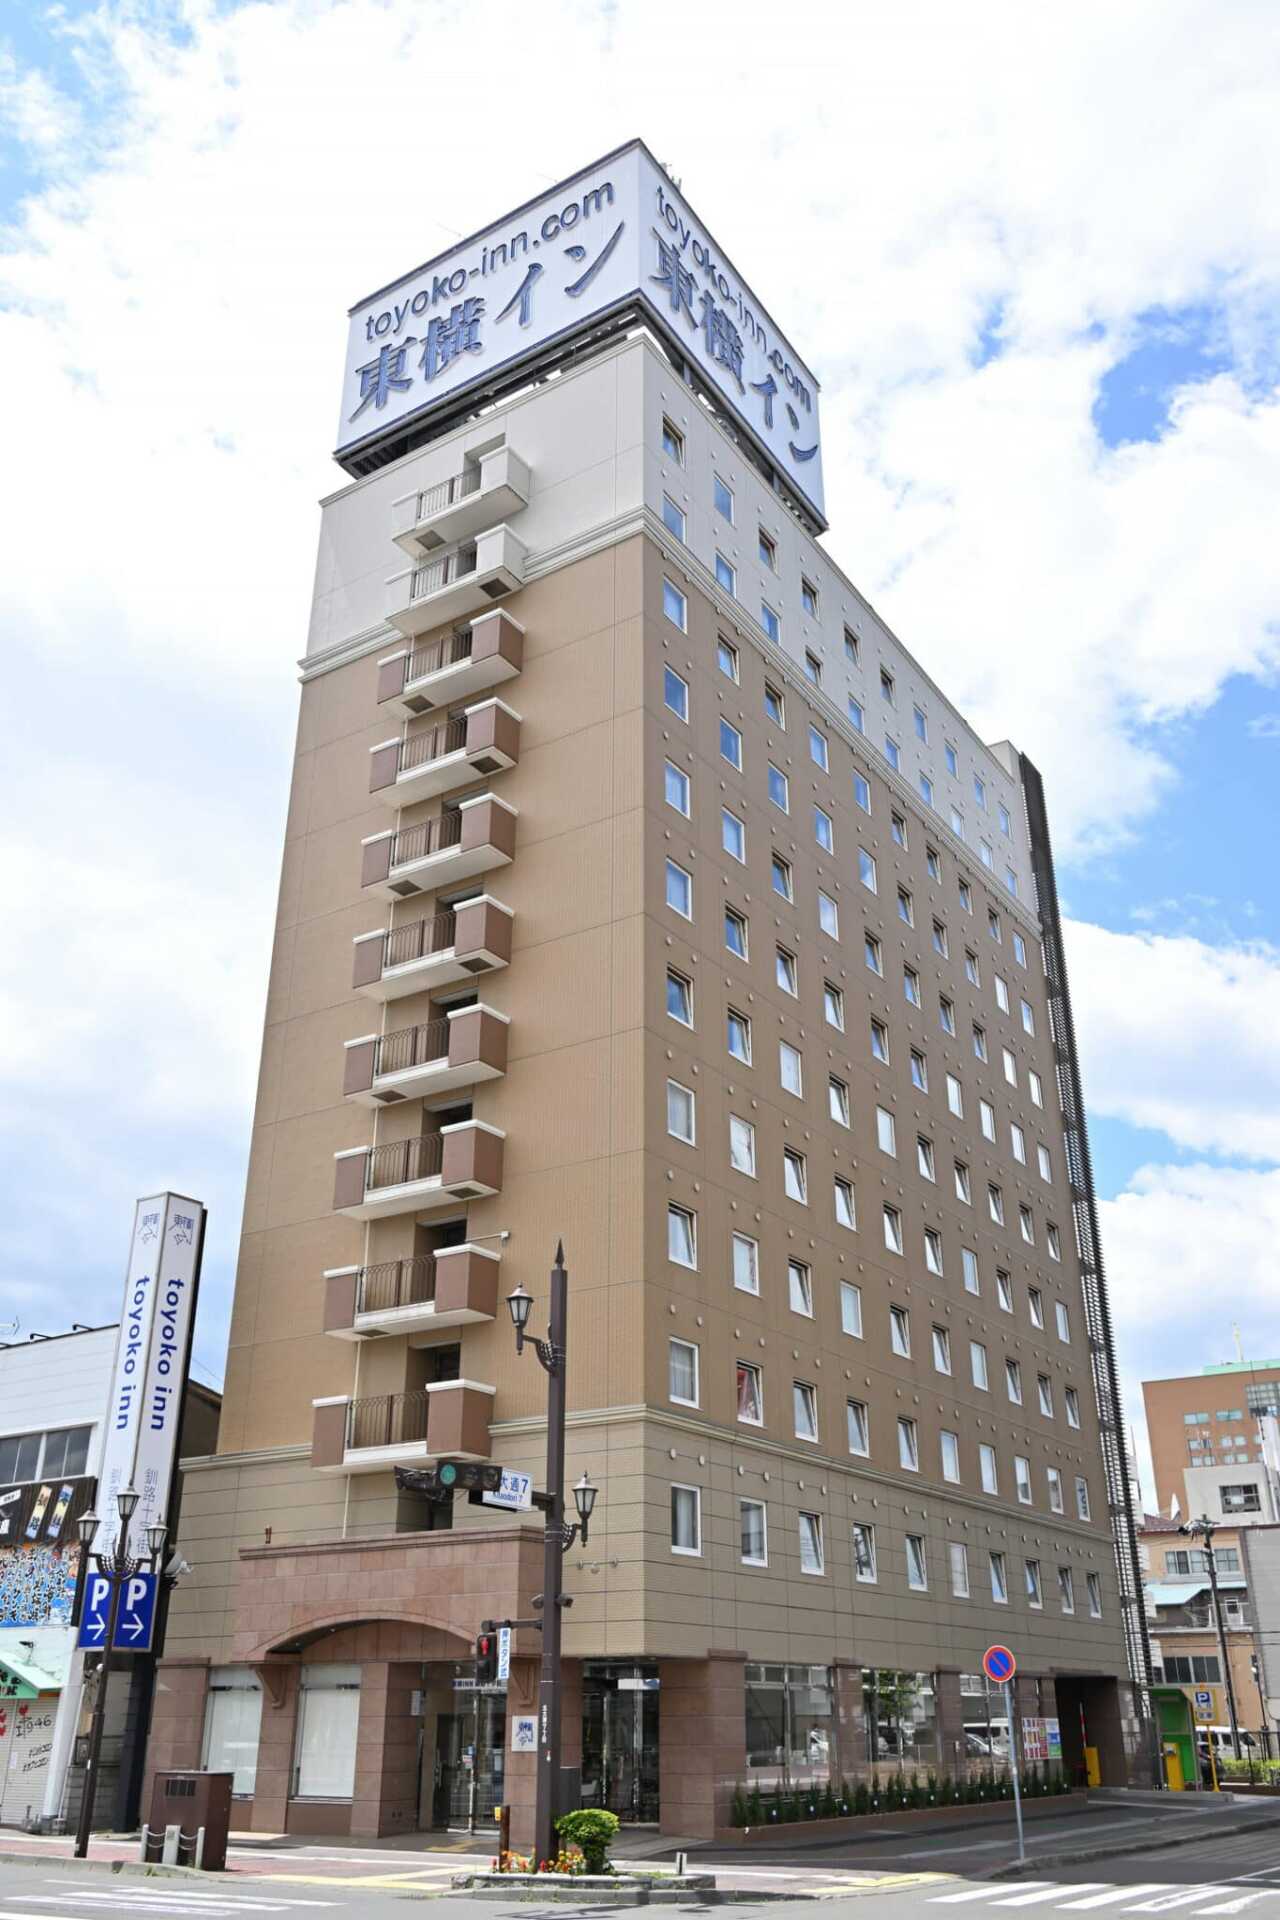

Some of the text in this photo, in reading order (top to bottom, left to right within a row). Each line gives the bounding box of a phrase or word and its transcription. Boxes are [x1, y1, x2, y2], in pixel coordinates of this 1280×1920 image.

[349, 220, 625, 424] 東横イン
[365, 181, 614, 343] toyoko-inn.com
[655, 185, 812, 413] toyoko-inn.com
[650, 226, 819, 463] 東横イン
[116, 1275, 150, 1430] toyoko inn
[150, 1278, 185, 1431] toyoko inn
[91, 1579, 110, 1611] P
[126, 1578, 148, 1611] P
